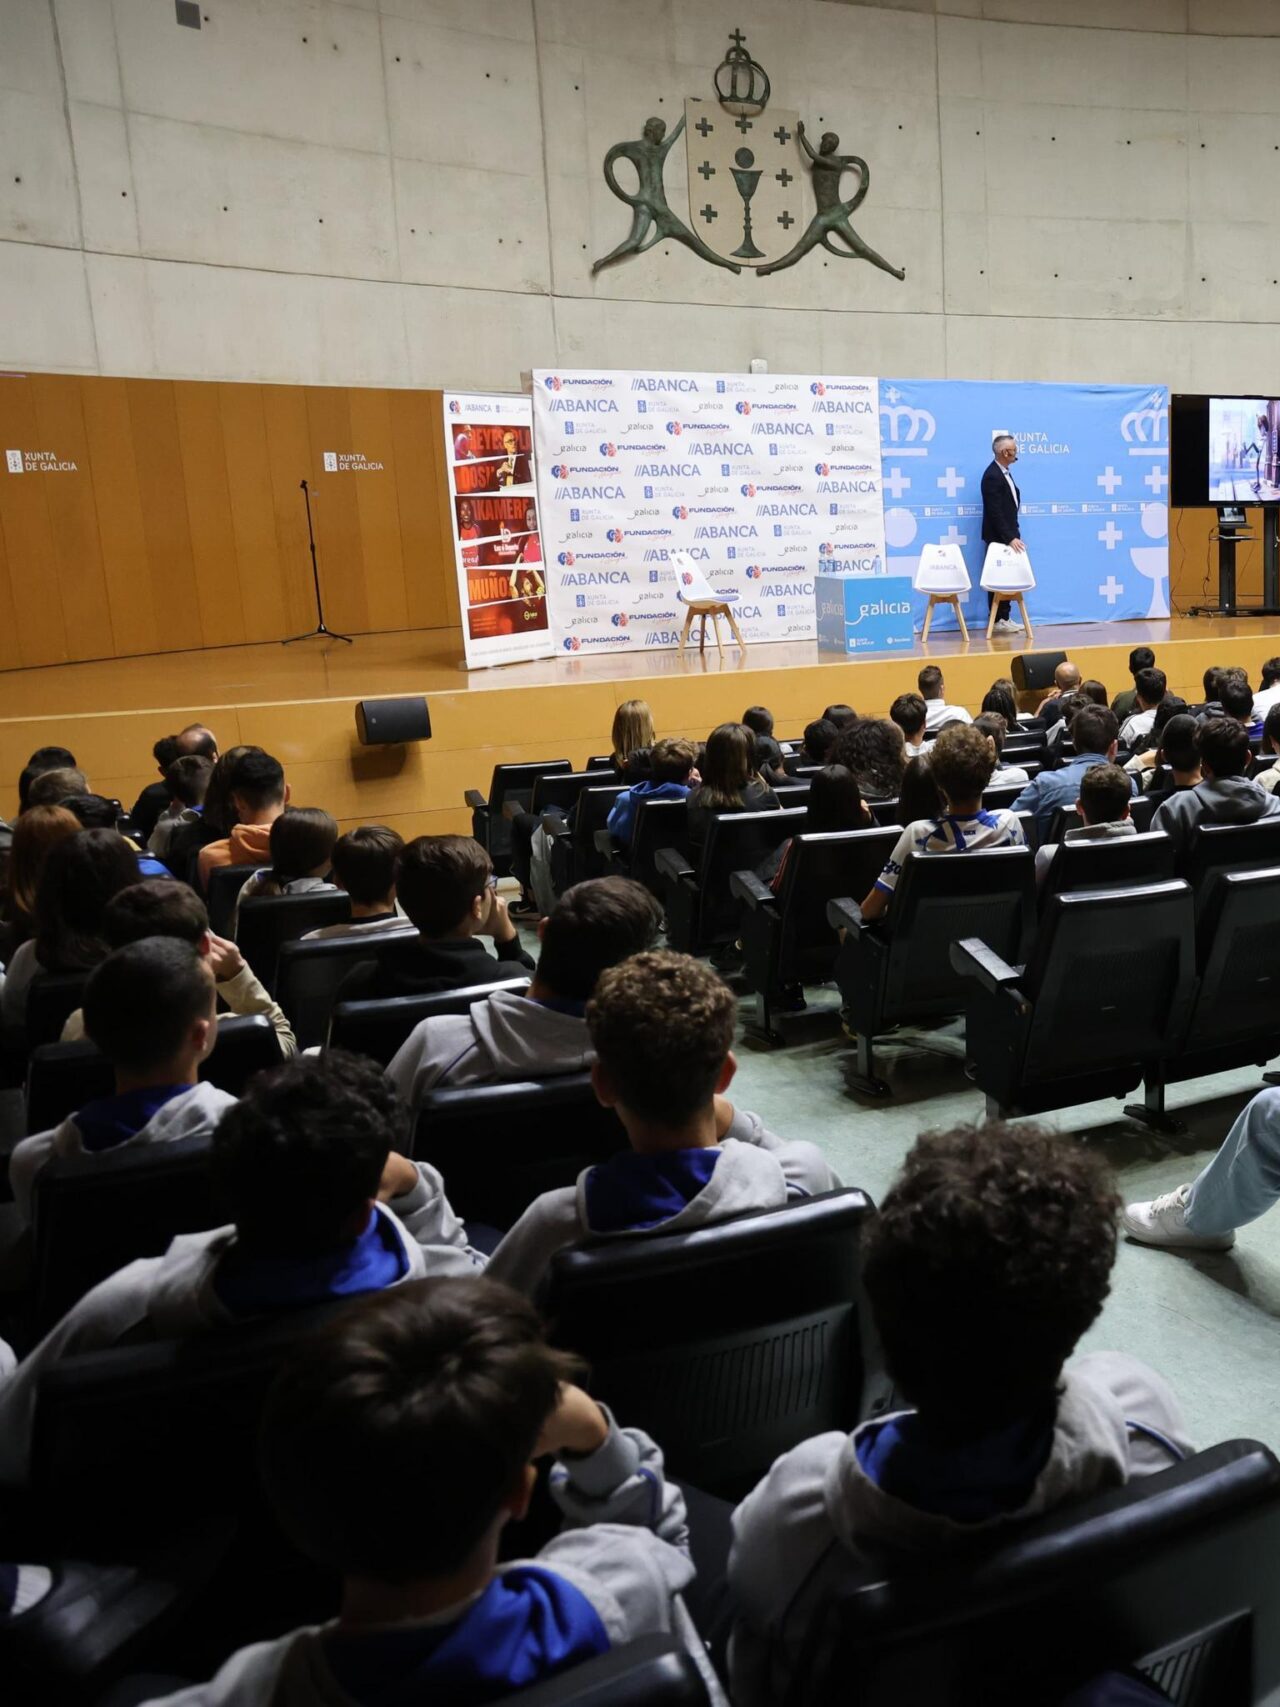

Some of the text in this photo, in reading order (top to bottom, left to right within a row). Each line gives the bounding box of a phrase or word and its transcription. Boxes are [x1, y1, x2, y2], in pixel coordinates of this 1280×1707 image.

[1012, 432, 1049, 442] XUNTA
[1029, 444, 1070, 454] GALICIA
[24, 452, 56, 461] XUNTA
[339, 454, 366, 462] XUNTA
[25, 462, 78, 471] DE GALICIA
[339, 462, 384, 471] DE GALICIA
[576, 551, 625, 559] FUNDACIÓN
[468, 571, 511, 601] MUÑO
[629, 612, 676, 620] FUNDACIÓN
[845, 599, 911, 625] galicia
